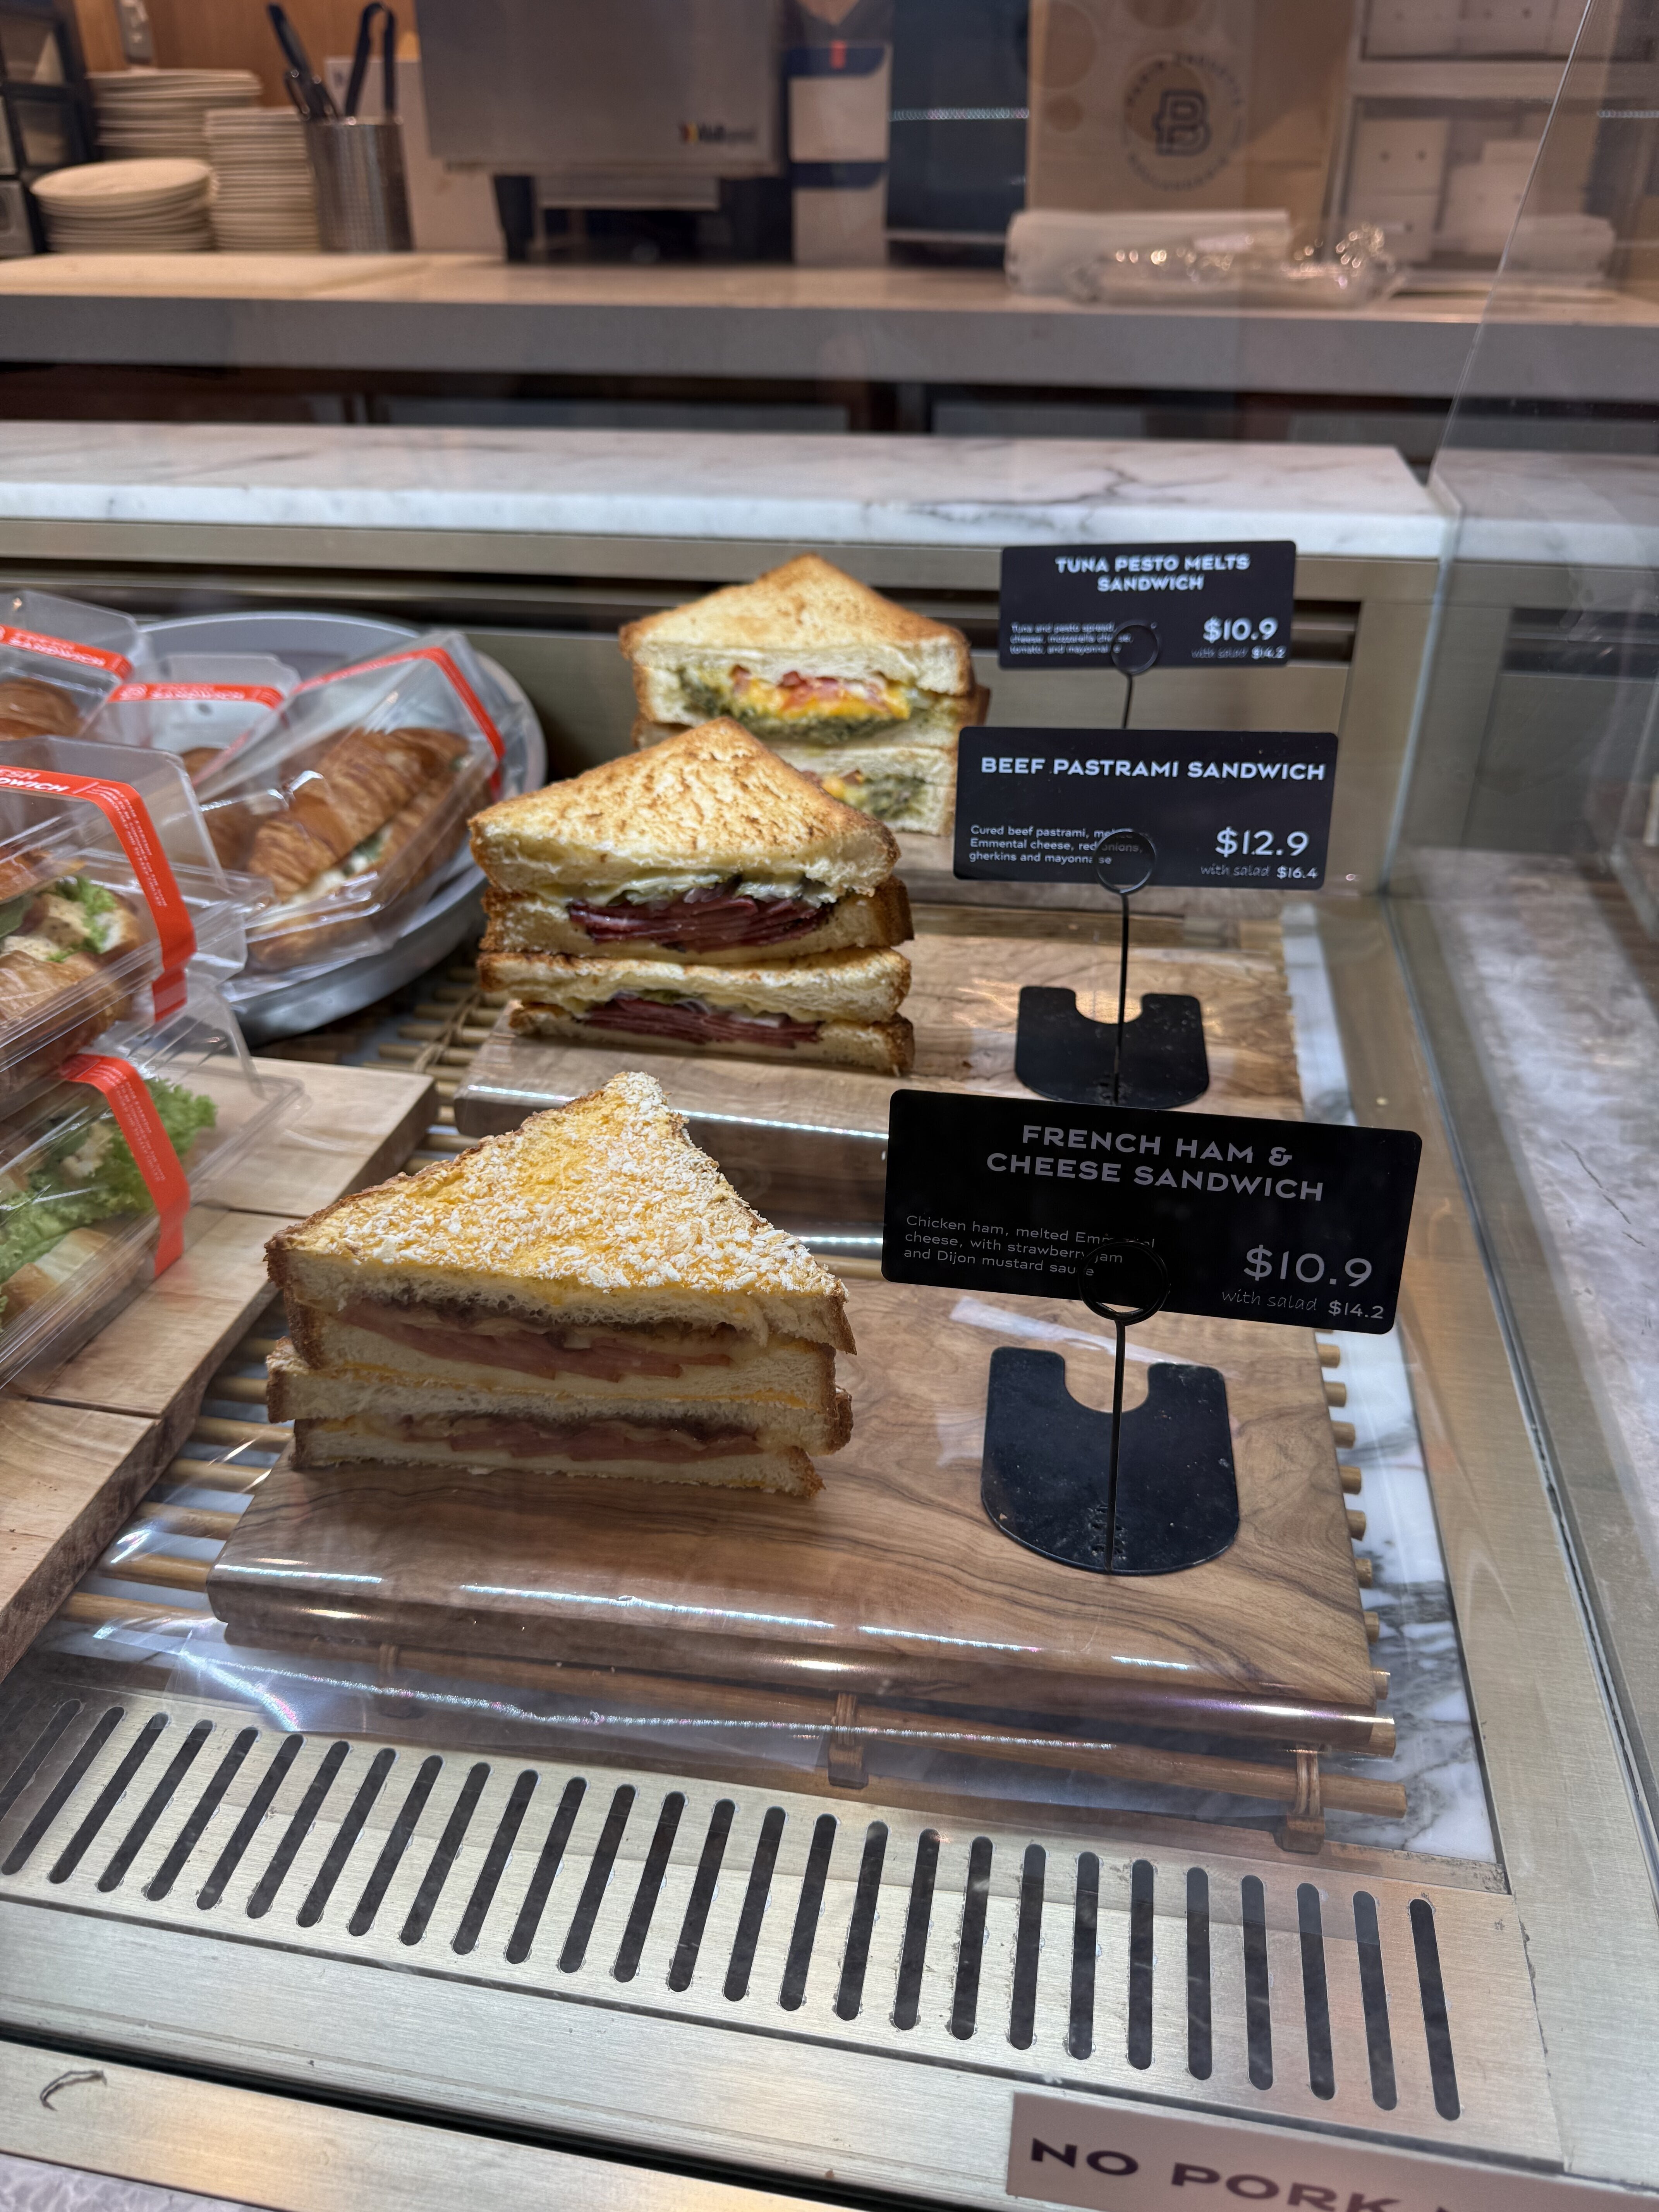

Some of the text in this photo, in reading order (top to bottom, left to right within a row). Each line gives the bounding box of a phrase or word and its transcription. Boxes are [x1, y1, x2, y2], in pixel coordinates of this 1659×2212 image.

[1055, 553, 1250, 573] TUNA PESTO MELTS
[1097, 574, 1205, 592] SANDWICH
[1203, 616, 1278, 643] $10.9
[981, 757, 1326, 780] BEEF PASTRAMI SANDWICH
[970, 825, 1004, 835] Cured
[1008, 826, 1034, 836] beef
[1036, 828, 1090, 839] pastrami,
[970, 838, 1027, 848] Emmental
[1030, 840, 1075, 852] cheese,
[1079, 842, 1097, 851] red
[1215, 826, 1309, 858] $12.9
[969, 852, 1113, 865] gherkins and mayonnase
[1200, 864, 1318, 879] with salad $16.4
[1022, 1125, 1293, 1166] FRENCH HAM &
[987, 1153, 1324, 1202] CHEESE SANDWICH
[905, 1231, 962, 1248] cheese,
[970, 1239, 1001, 1250] with
[907, 1215, 966, 1231] Chicken
[972, 1221, 1009, 1236] ham,
[1016, 1228, 1068, 1241] melted
[904, 1249, 1094, 1276] and Dijon mustard saue
[1243, 1245, 1372, 1287] $10.9
[1222, 1289, 1384, 1319] with salad $14.2
[1030, 2138, 1400, 2212] NO PORK
